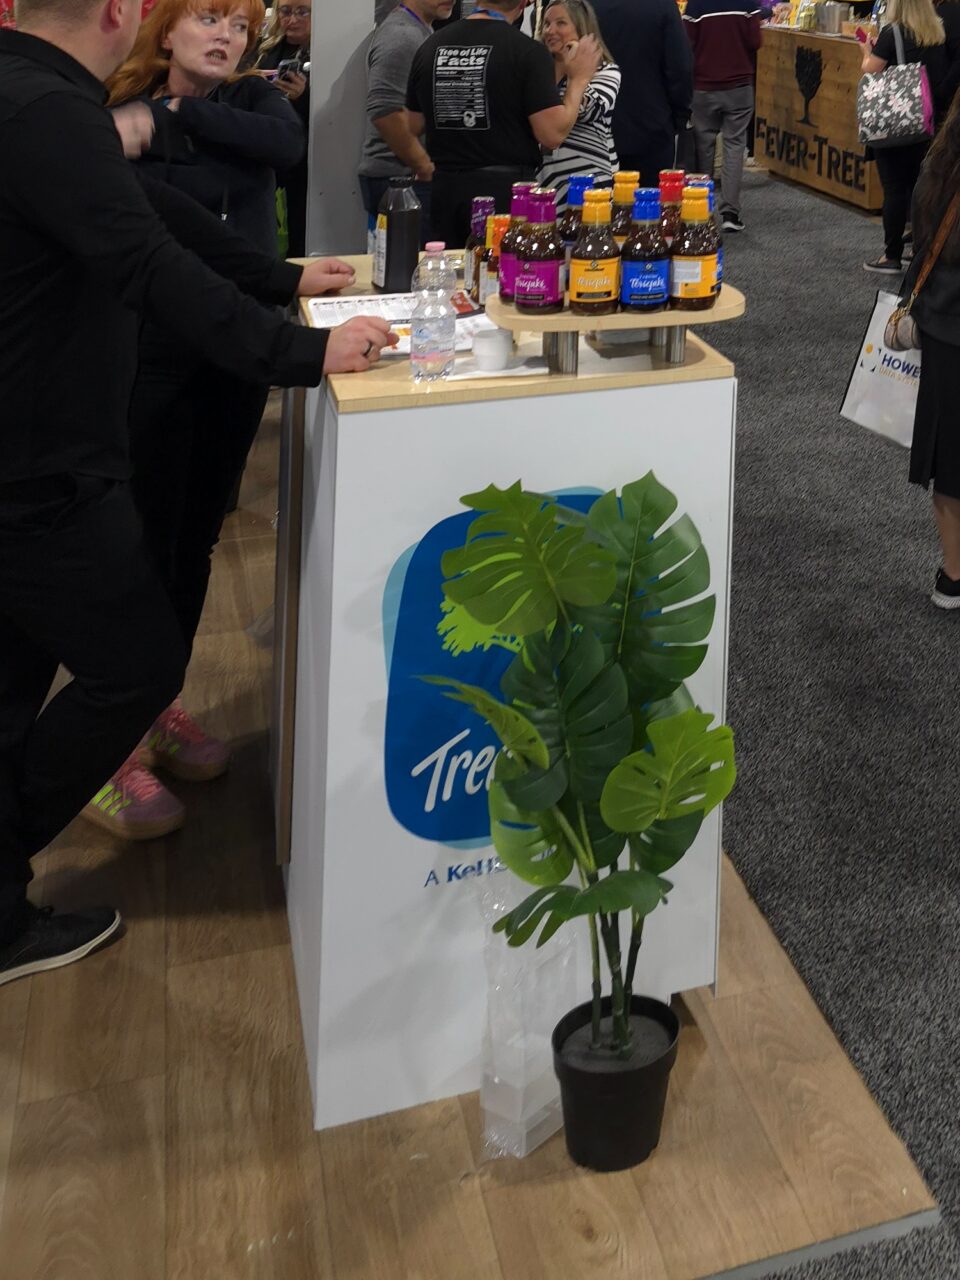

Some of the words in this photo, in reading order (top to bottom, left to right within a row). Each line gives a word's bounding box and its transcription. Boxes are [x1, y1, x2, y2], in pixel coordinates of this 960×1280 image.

[438, 48, 460, 57] Tree
[459, 48, 471, 57] of
[470, 47, 489, 57] Life
[436, 55, 486, 66] Facts
[756, 117, 866, 192] FEVER-TREE
[424, 870, 440, 888] A
